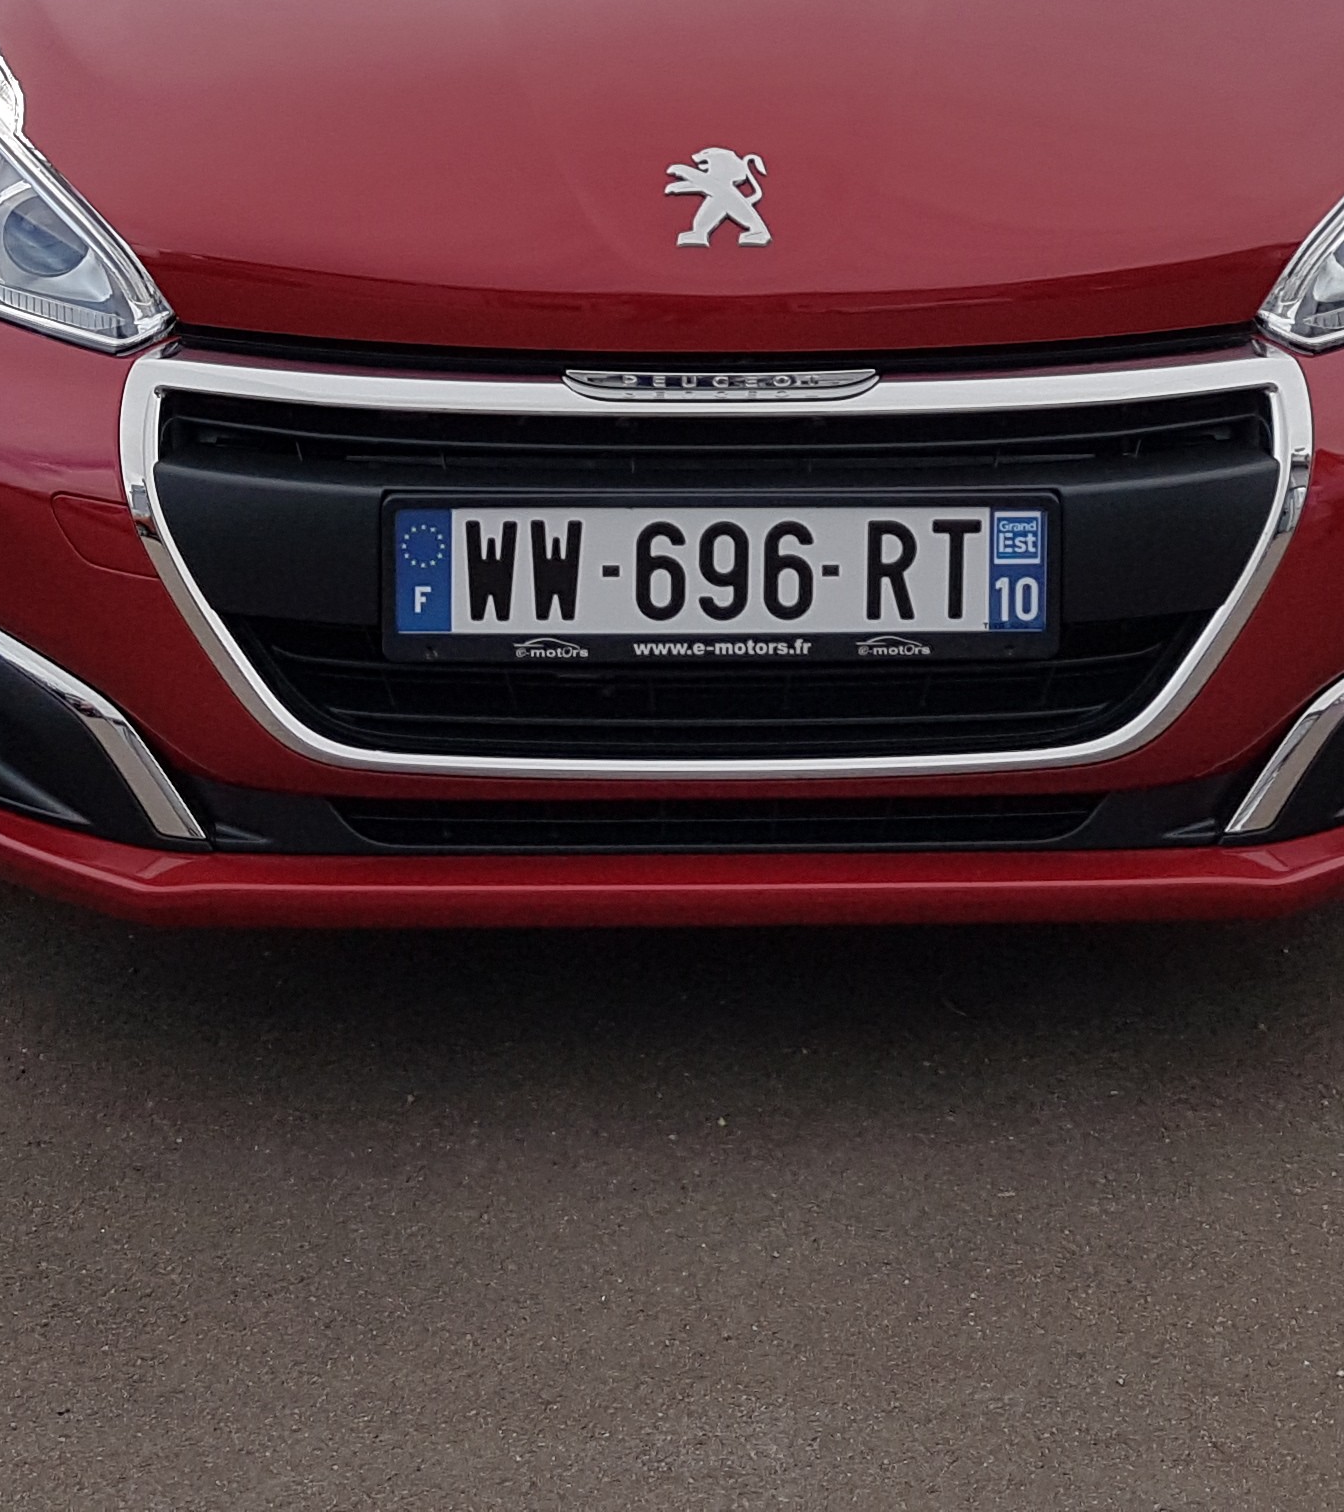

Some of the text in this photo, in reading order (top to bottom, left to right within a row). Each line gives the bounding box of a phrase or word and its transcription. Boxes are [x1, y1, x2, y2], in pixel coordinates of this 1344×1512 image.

[622, 374, 820, 388] PEUGEOT
[998, 520, 1037, 532] Grand
[998, 532, 1037, 553] Est
[465, 519, 982, 622] WW-696-RT
[413, 585, 432, 614] F
[995, 576, 1039, 622] 10
[633, 638, 812, 656] www.e-motors.fr
